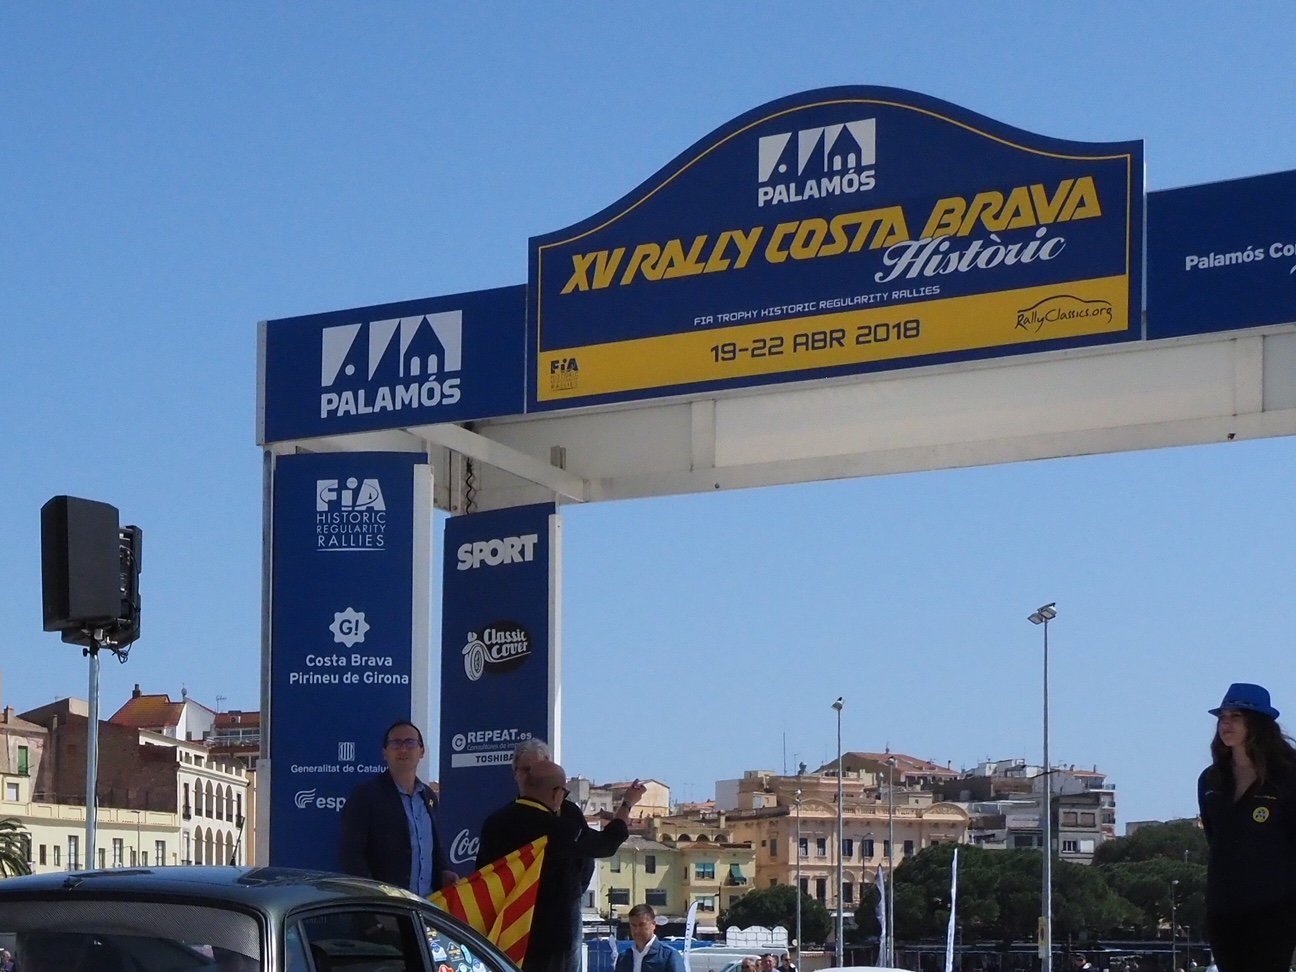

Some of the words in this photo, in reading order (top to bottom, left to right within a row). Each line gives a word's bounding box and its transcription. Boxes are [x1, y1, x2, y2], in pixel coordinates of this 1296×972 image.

[758, 169, 875, 207] PALAMÓS
[560, 248, 626, 295] XV
[620, 226, 763, 286] RALLY
[765, 205, 911, 264] COSTA
[921, 175, 1102, 240] BRAVA
[874, 226, 1066, 283] Històric
[1185, 245, 1265, 271] Palamós
[1269, 242, 1296, 259] Co
[694, 315, 714, 326] FIA
[716, 309, 759, 324] TROPHY
[761, 301, 817, 317] HISTORIC
[819, 292, 889, 309] REGULARITY
[891, 285, 941, 300] RALLIES
[1015, 305, 1113, 333] RallyClassics.org
[710, 336, 785, 363] 19-22
[793, 328, 846, 353] ABR
[855, 319, 921, 345] 2018
[320, 376, 461, 418] PALAMÓS
[316, 512, 386, 524] HISTORIC
[316, 525, 386, 534] REGULARITY
[317, 534, 385, 547] RALLIES
[457, 534, 538, 571] SPORT
[484, 628, 527, 645] Classic
[305, 654, 347, 667] Costa
[351, 654, 393, 667] Brava
[289, 672, 339, 685] Pirineu
[342, 672, 360, 684] de
[363, 672, 409, 685] Girona
[290, 764, 340, 773] Generalitat
[343, 764, 354, 773] de
[357, 764, 389, 773] Catalu
